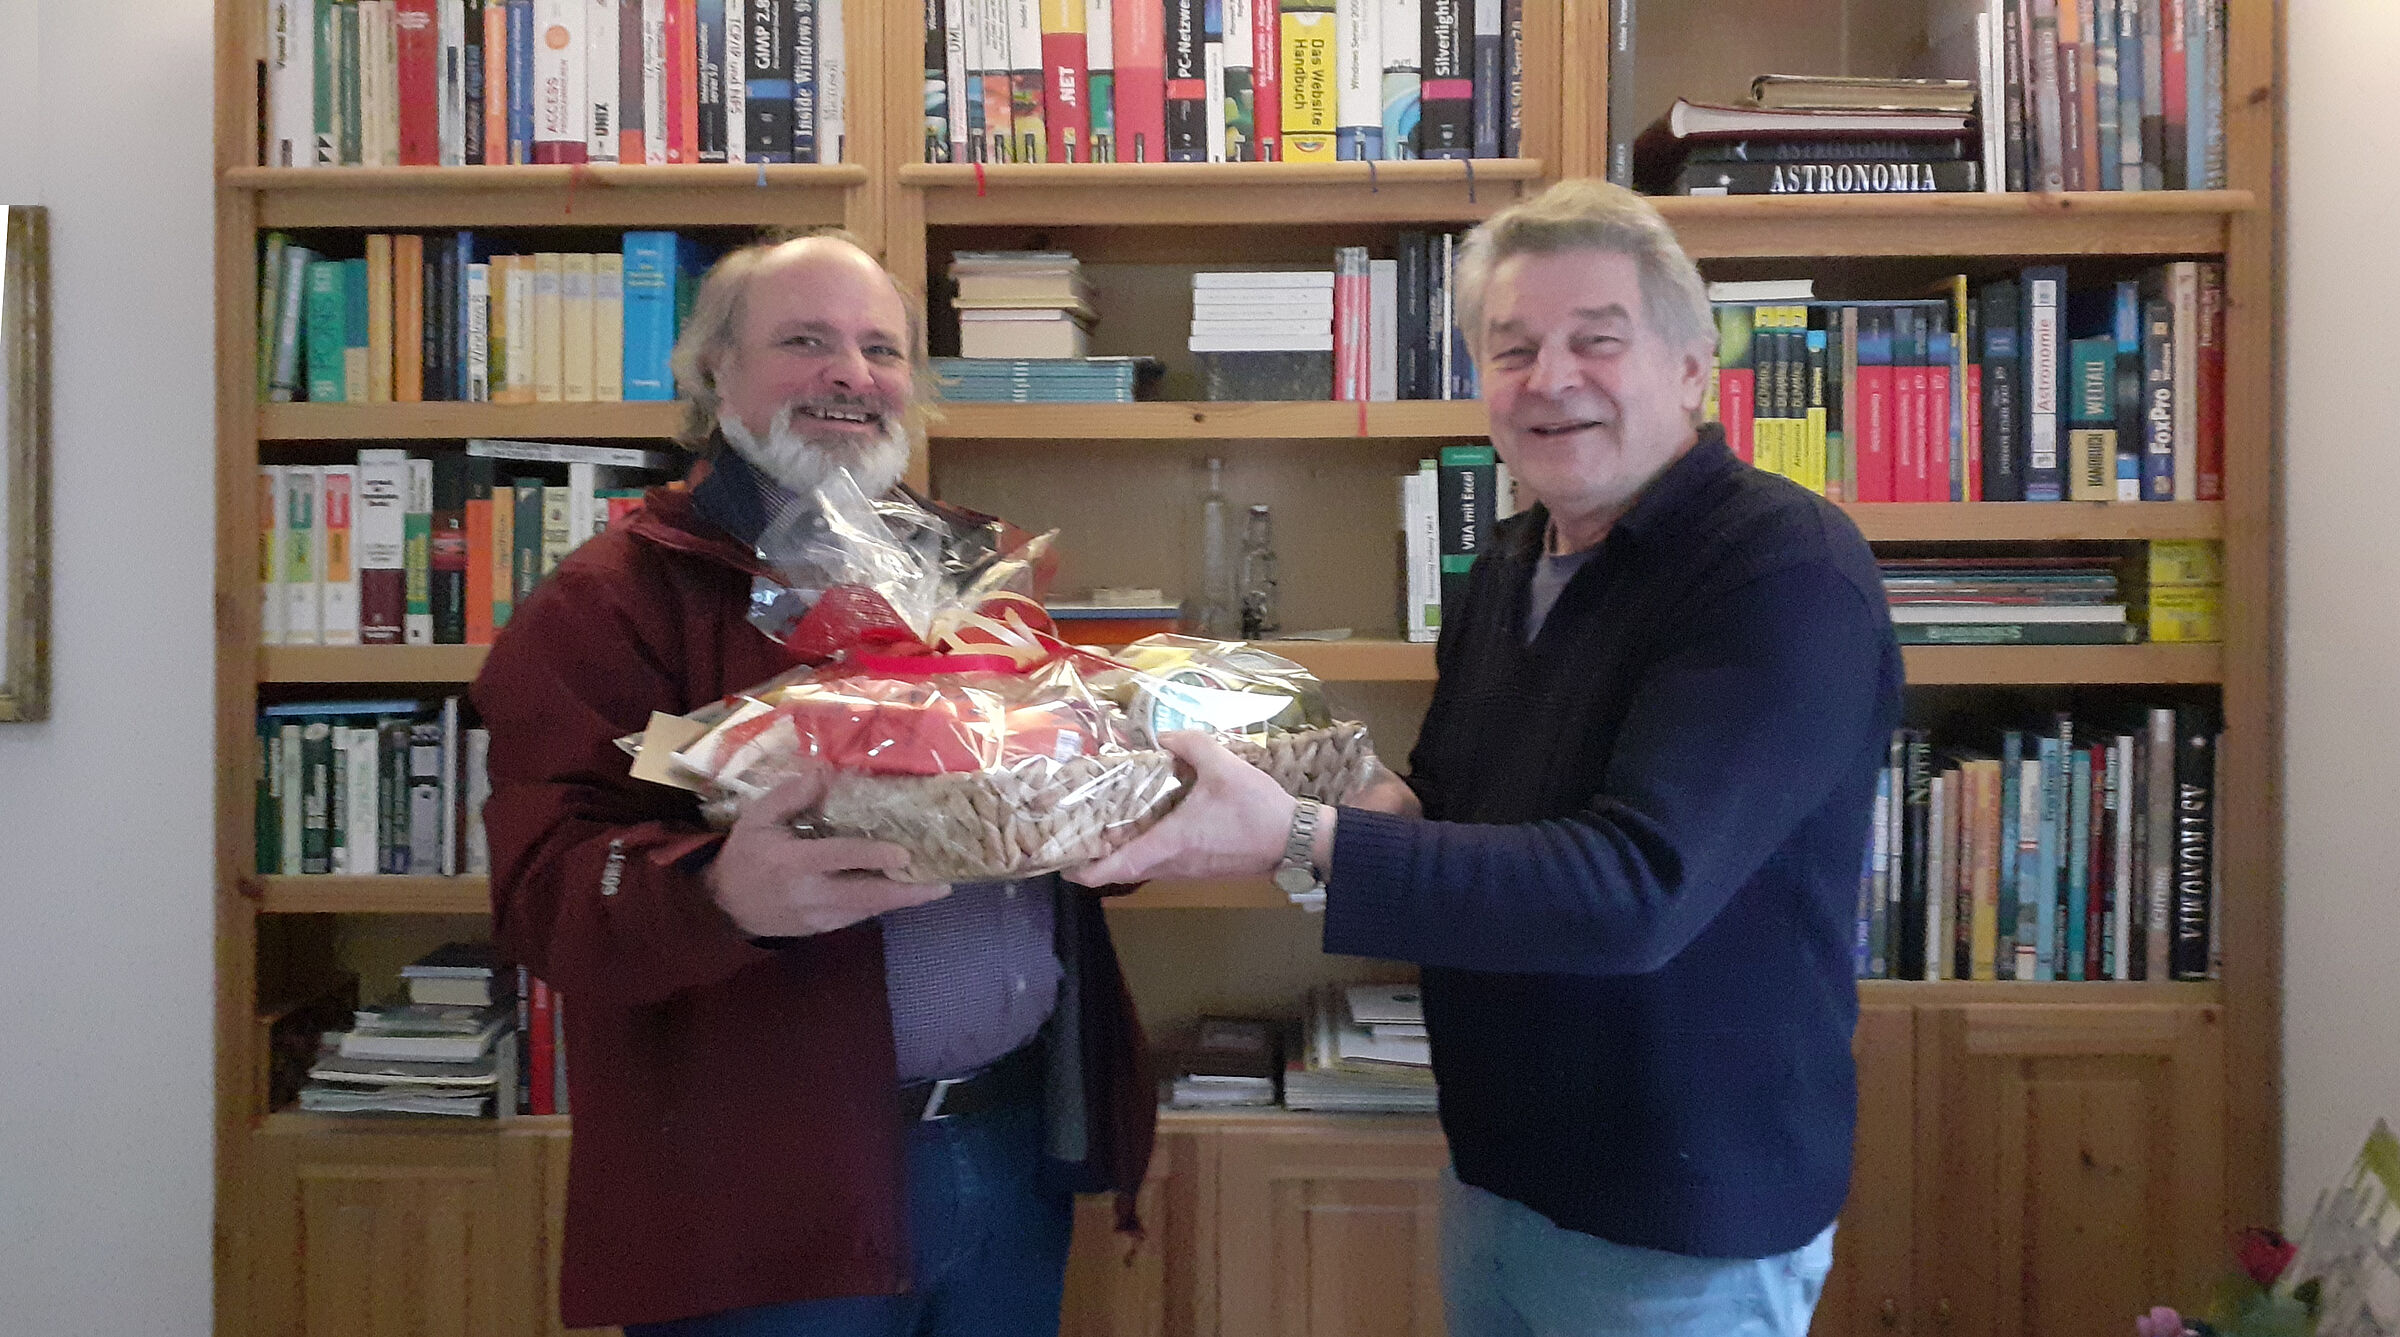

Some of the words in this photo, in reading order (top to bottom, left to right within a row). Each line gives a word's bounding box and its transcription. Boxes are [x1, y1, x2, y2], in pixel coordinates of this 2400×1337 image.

[754, 26, 771, 69] GIMP
[793, 17, 813, 84] Windows
[1311, 38, 1325, 57] Das
[1434, 0, 1454, 76] Silverlight
[1057, 65, 1076, 107] .NET
[1294, 38, 1306, 109] Handbuch
[1350, 50, 1359, 90] Windows
[546, 77, 559, 133] ACCESS
[594, 102, 609, 137] UNIX
[793, 87, 813, 137] Inside
[1311, 69, 1325, 127] Website
[1769, 164, 1937, 193] ASTRONOMIA
[2039, 318, 2053, 412] Astronomie
[2086, 361, 2105, 415] WELTALL
[2149, 388, 2171, 454] FoxPro
[2087, 433, 2104, 487] HANDBUCH
[1461, 471, 1475, 500] Excel
[1461, 524, 1476, 550] VBA
[1462, 503, 1475, 523] mit
